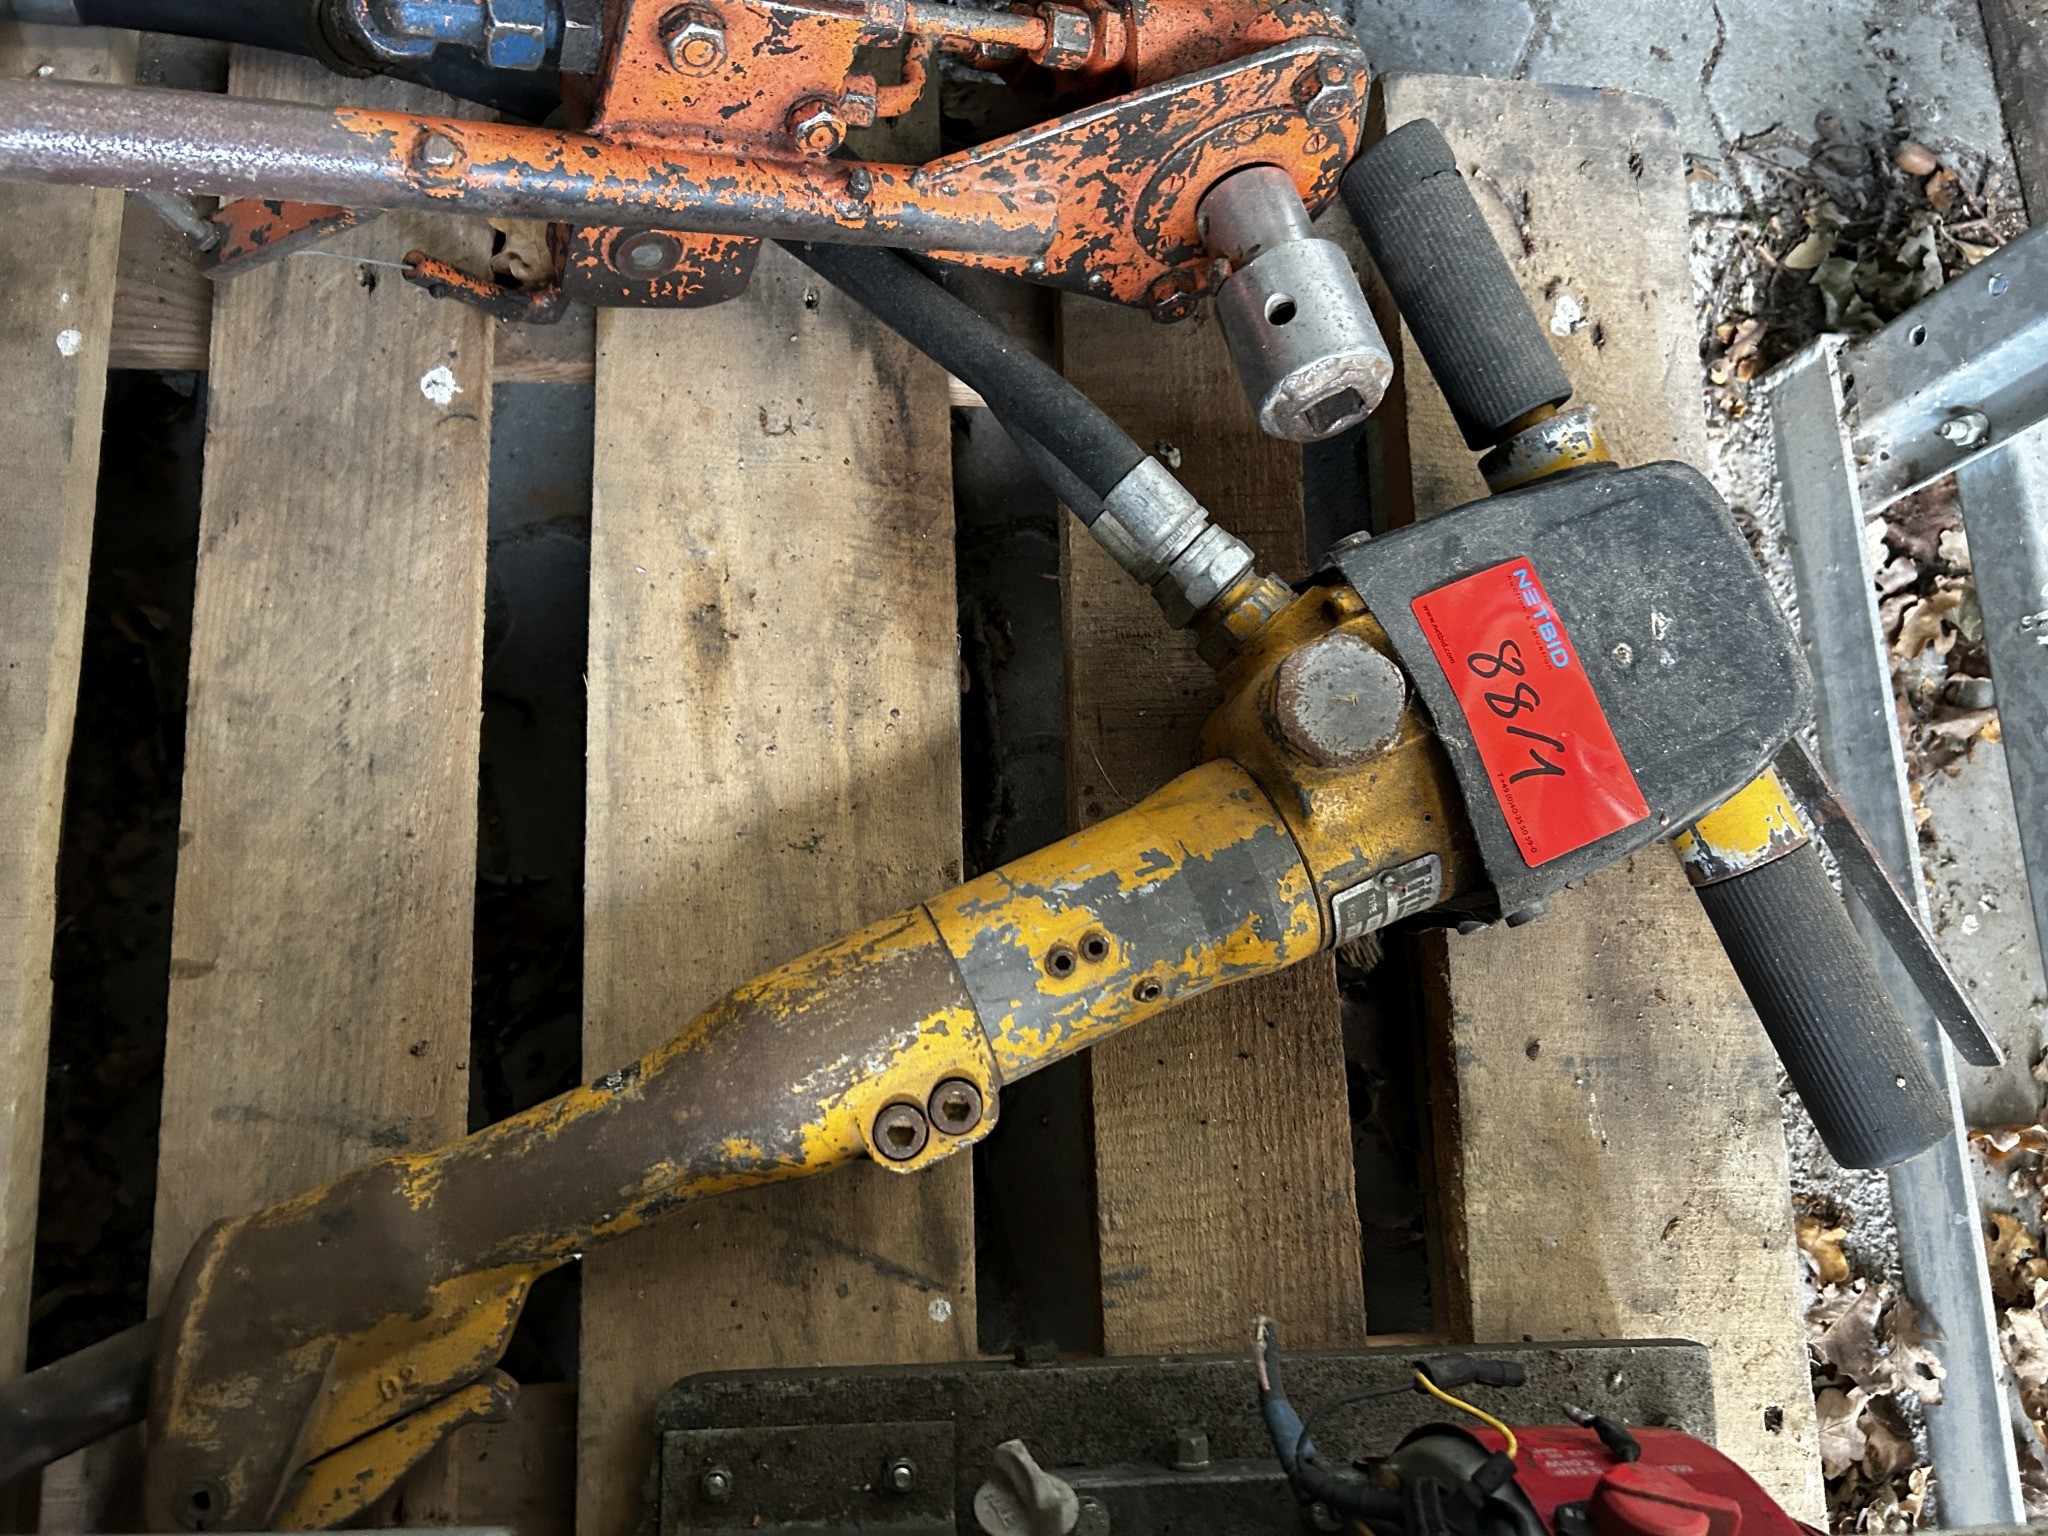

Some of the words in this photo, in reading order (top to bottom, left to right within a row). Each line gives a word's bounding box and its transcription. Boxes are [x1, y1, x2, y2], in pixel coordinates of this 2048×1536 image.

[1506, 575, 1527, 612] Auction
[1513, 568, 1569, 669] NETBID
[1422, 604, 1455, 664] www.netbid.com
[1467, 639, 1566, 784] 88/1
[1500, 779, 1510, 793] +49
[1519, 825, 1529, 836] 50
[1524, 836, 1538, 853] 59-0
